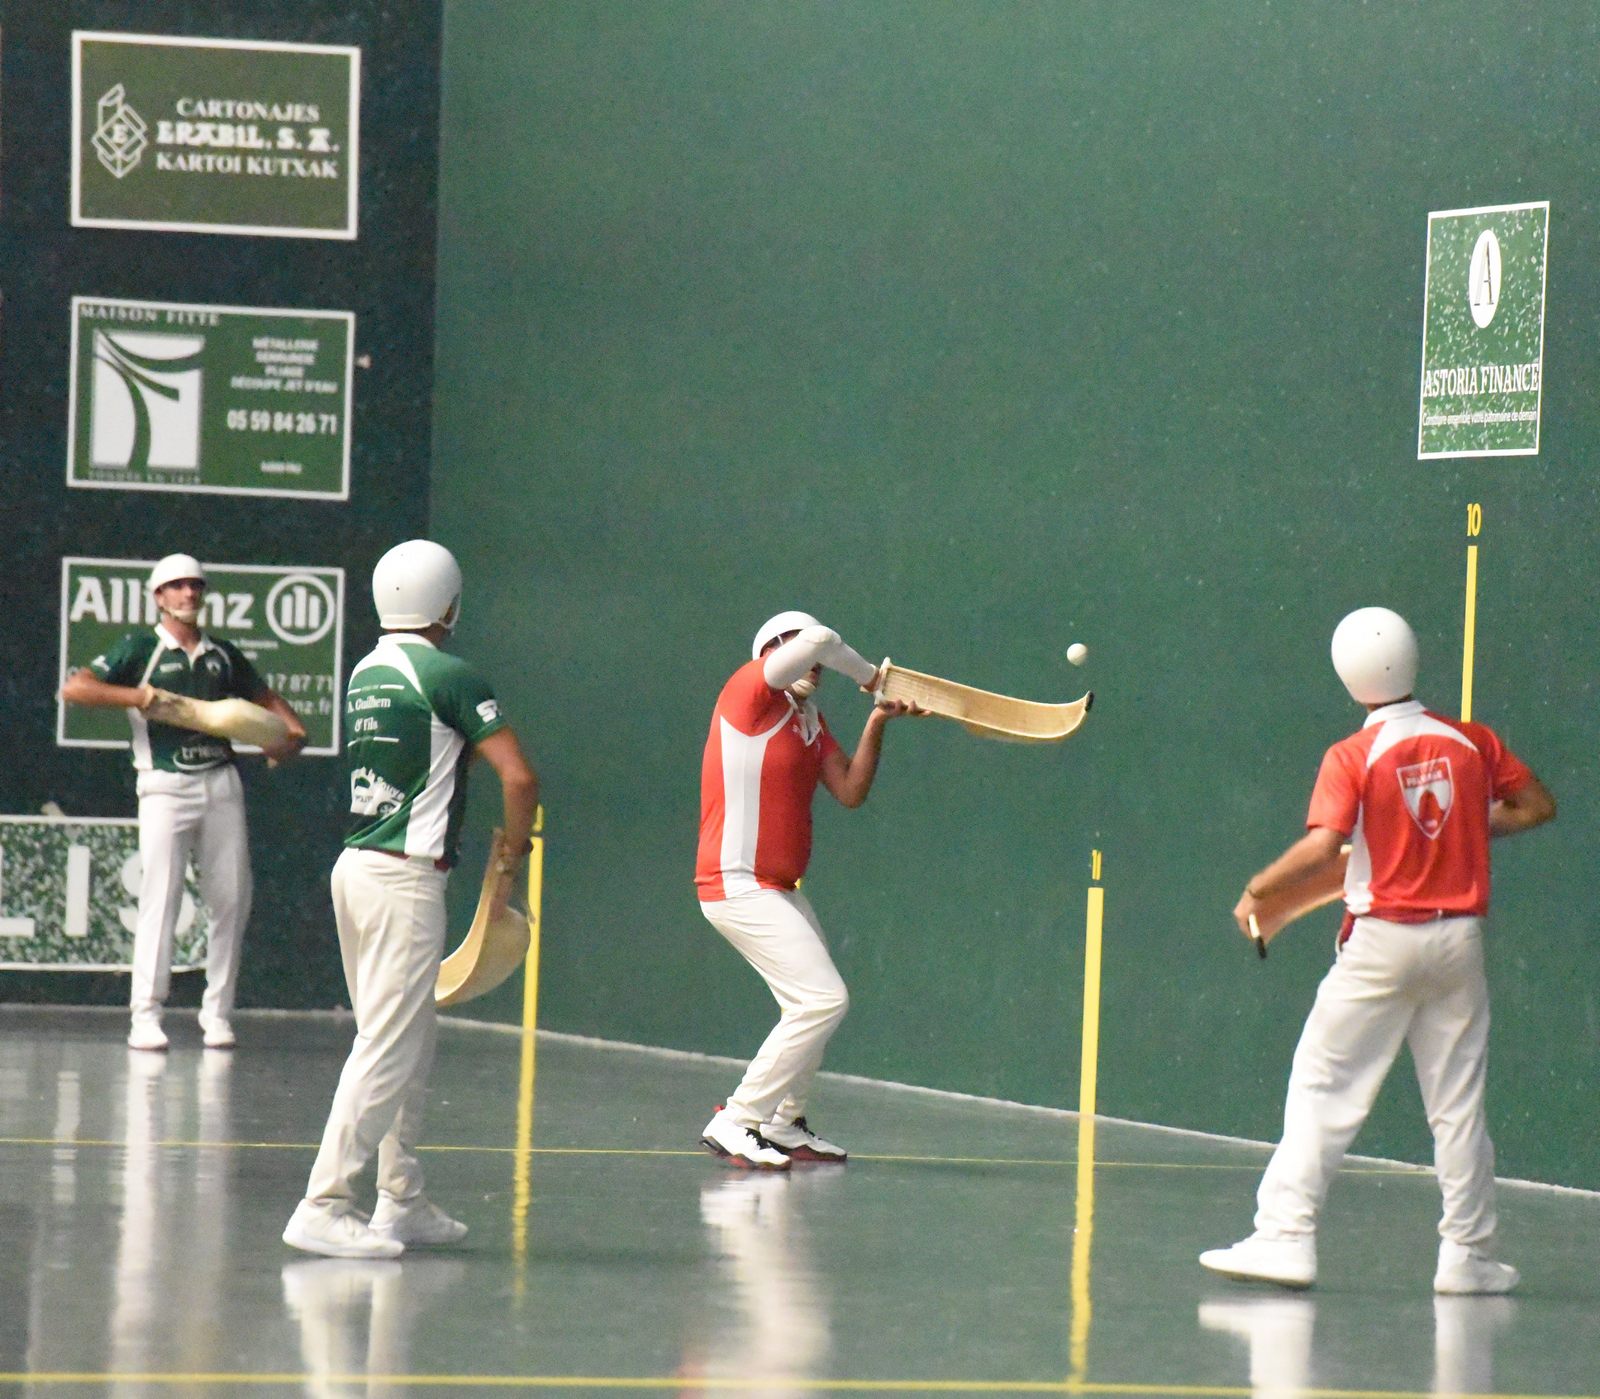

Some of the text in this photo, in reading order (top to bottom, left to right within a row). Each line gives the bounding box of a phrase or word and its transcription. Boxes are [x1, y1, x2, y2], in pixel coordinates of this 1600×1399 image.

[176, 98, 320, 123] CARTONAJES
[156, 152, 338, 179] KARTOI KUTXAK
[80, 303, 157, 322] MAISON
[1423, 363, 1539, 398] ASTORIA FINANCE
[318, 414, 337, 435] 71
[1466, 503, 1482, 537] 10
[69, 576, 254, 629] Allinz
[1091, 848, 1102, 881] 11
